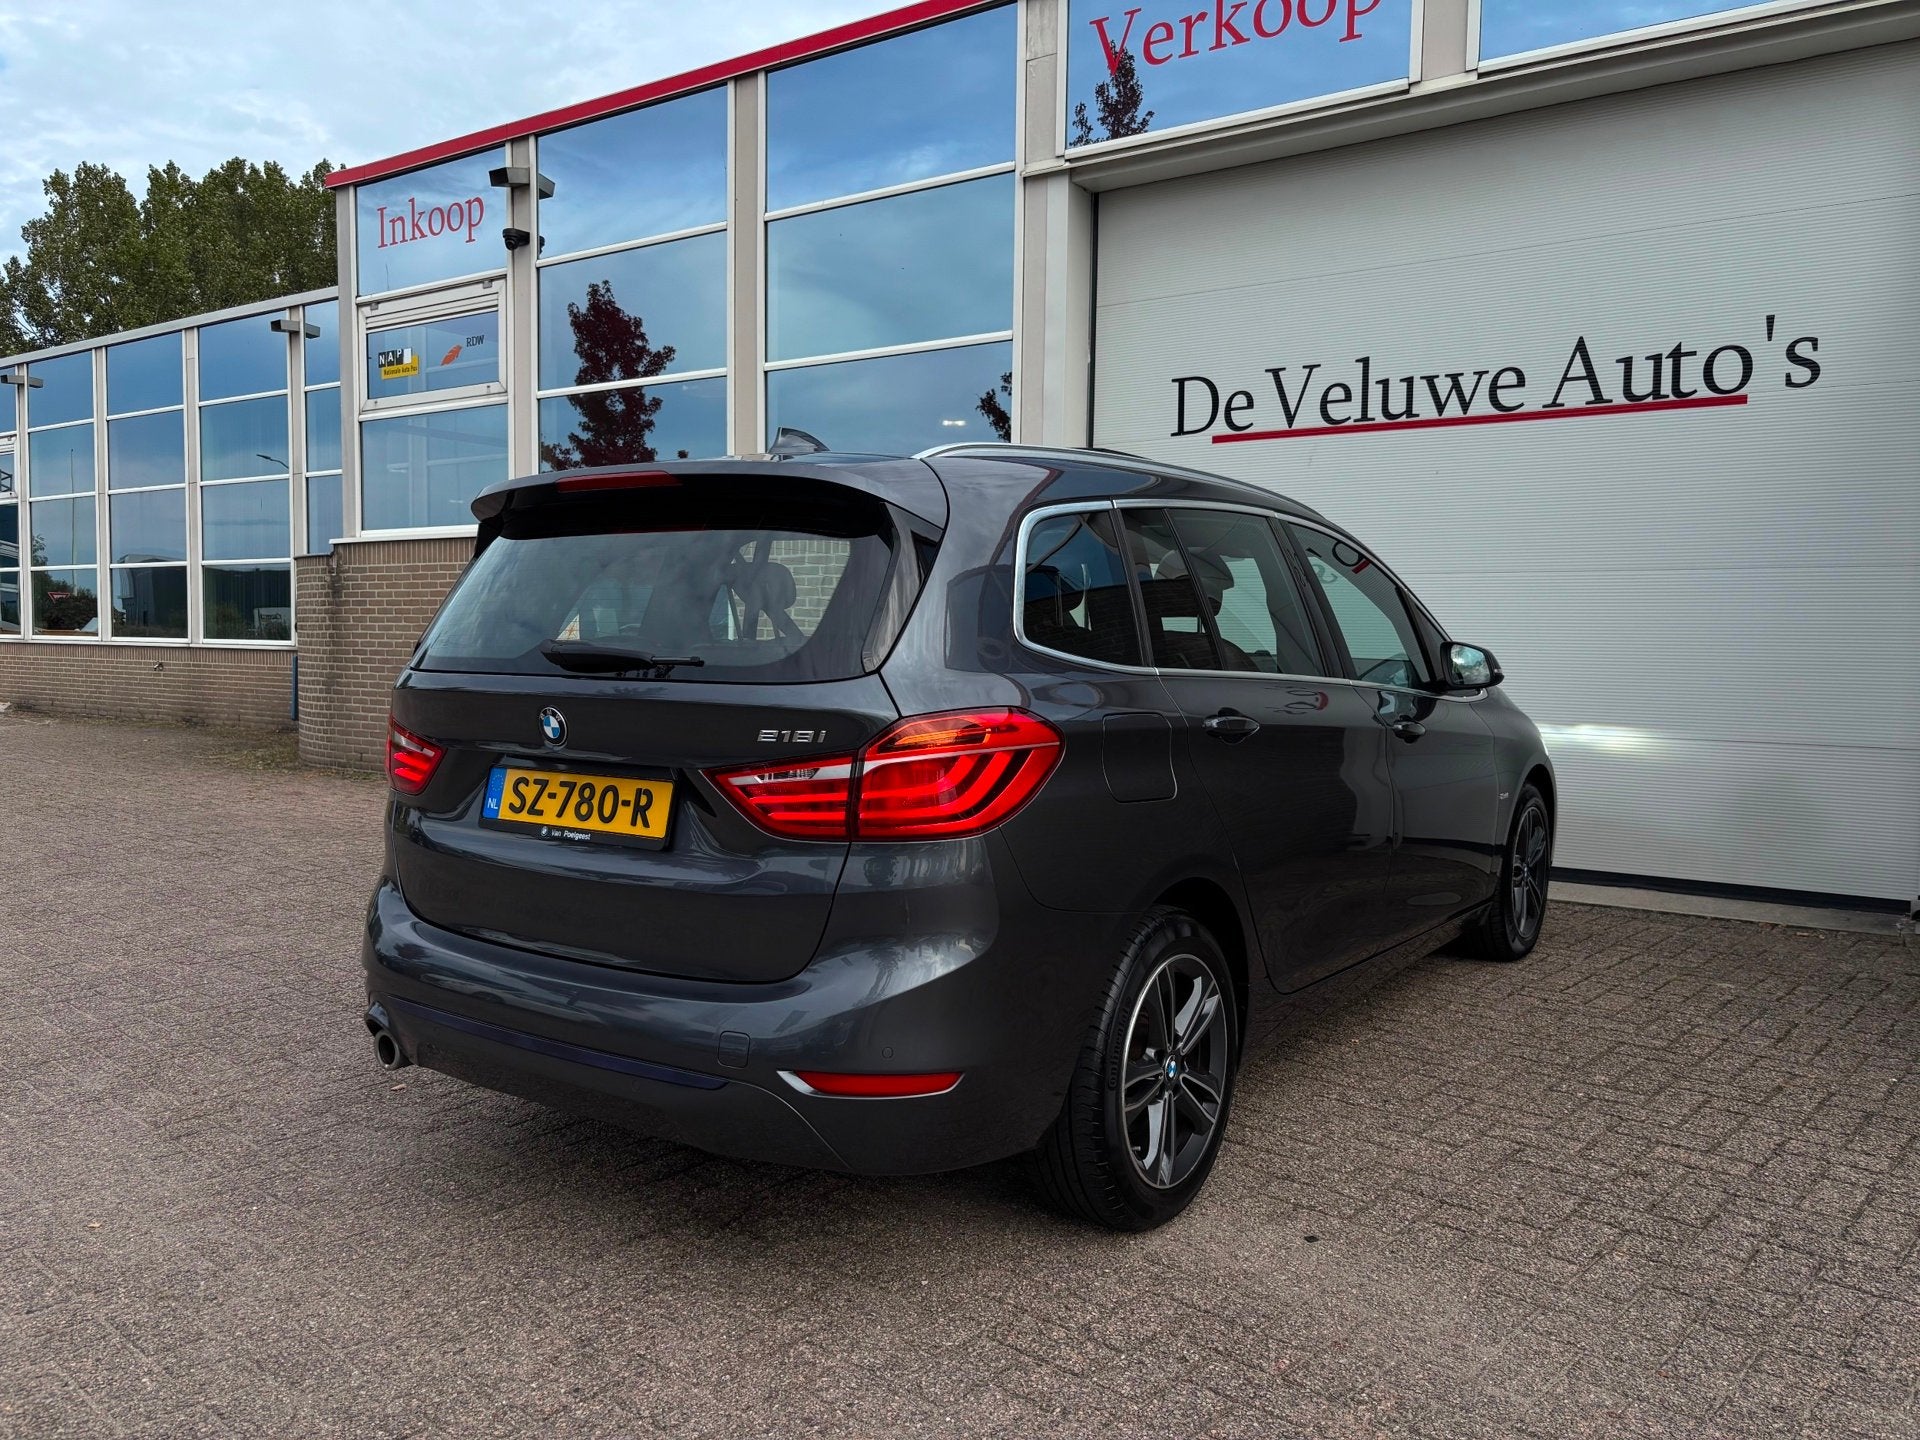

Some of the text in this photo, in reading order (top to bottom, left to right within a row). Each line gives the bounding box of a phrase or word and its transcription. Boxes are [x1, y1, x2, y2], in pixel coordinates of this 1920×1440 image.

[1089, 0, 1383, 76] Verkoop
[377, 197, 485, 249] Inkoop
[466, 335, 485, 347] RDW
[379, 348, 402, 365] NAP
[1170, 314, 1821, 437] De Veluwe Auto's
[539, 707, 562, 722] BMW
[757, 729, 827, 743] 218i
[487, 797, 499, 810] NL
[508, 776, 654, 829] SZ-780-R
[551, 829, 562, 837] Van
